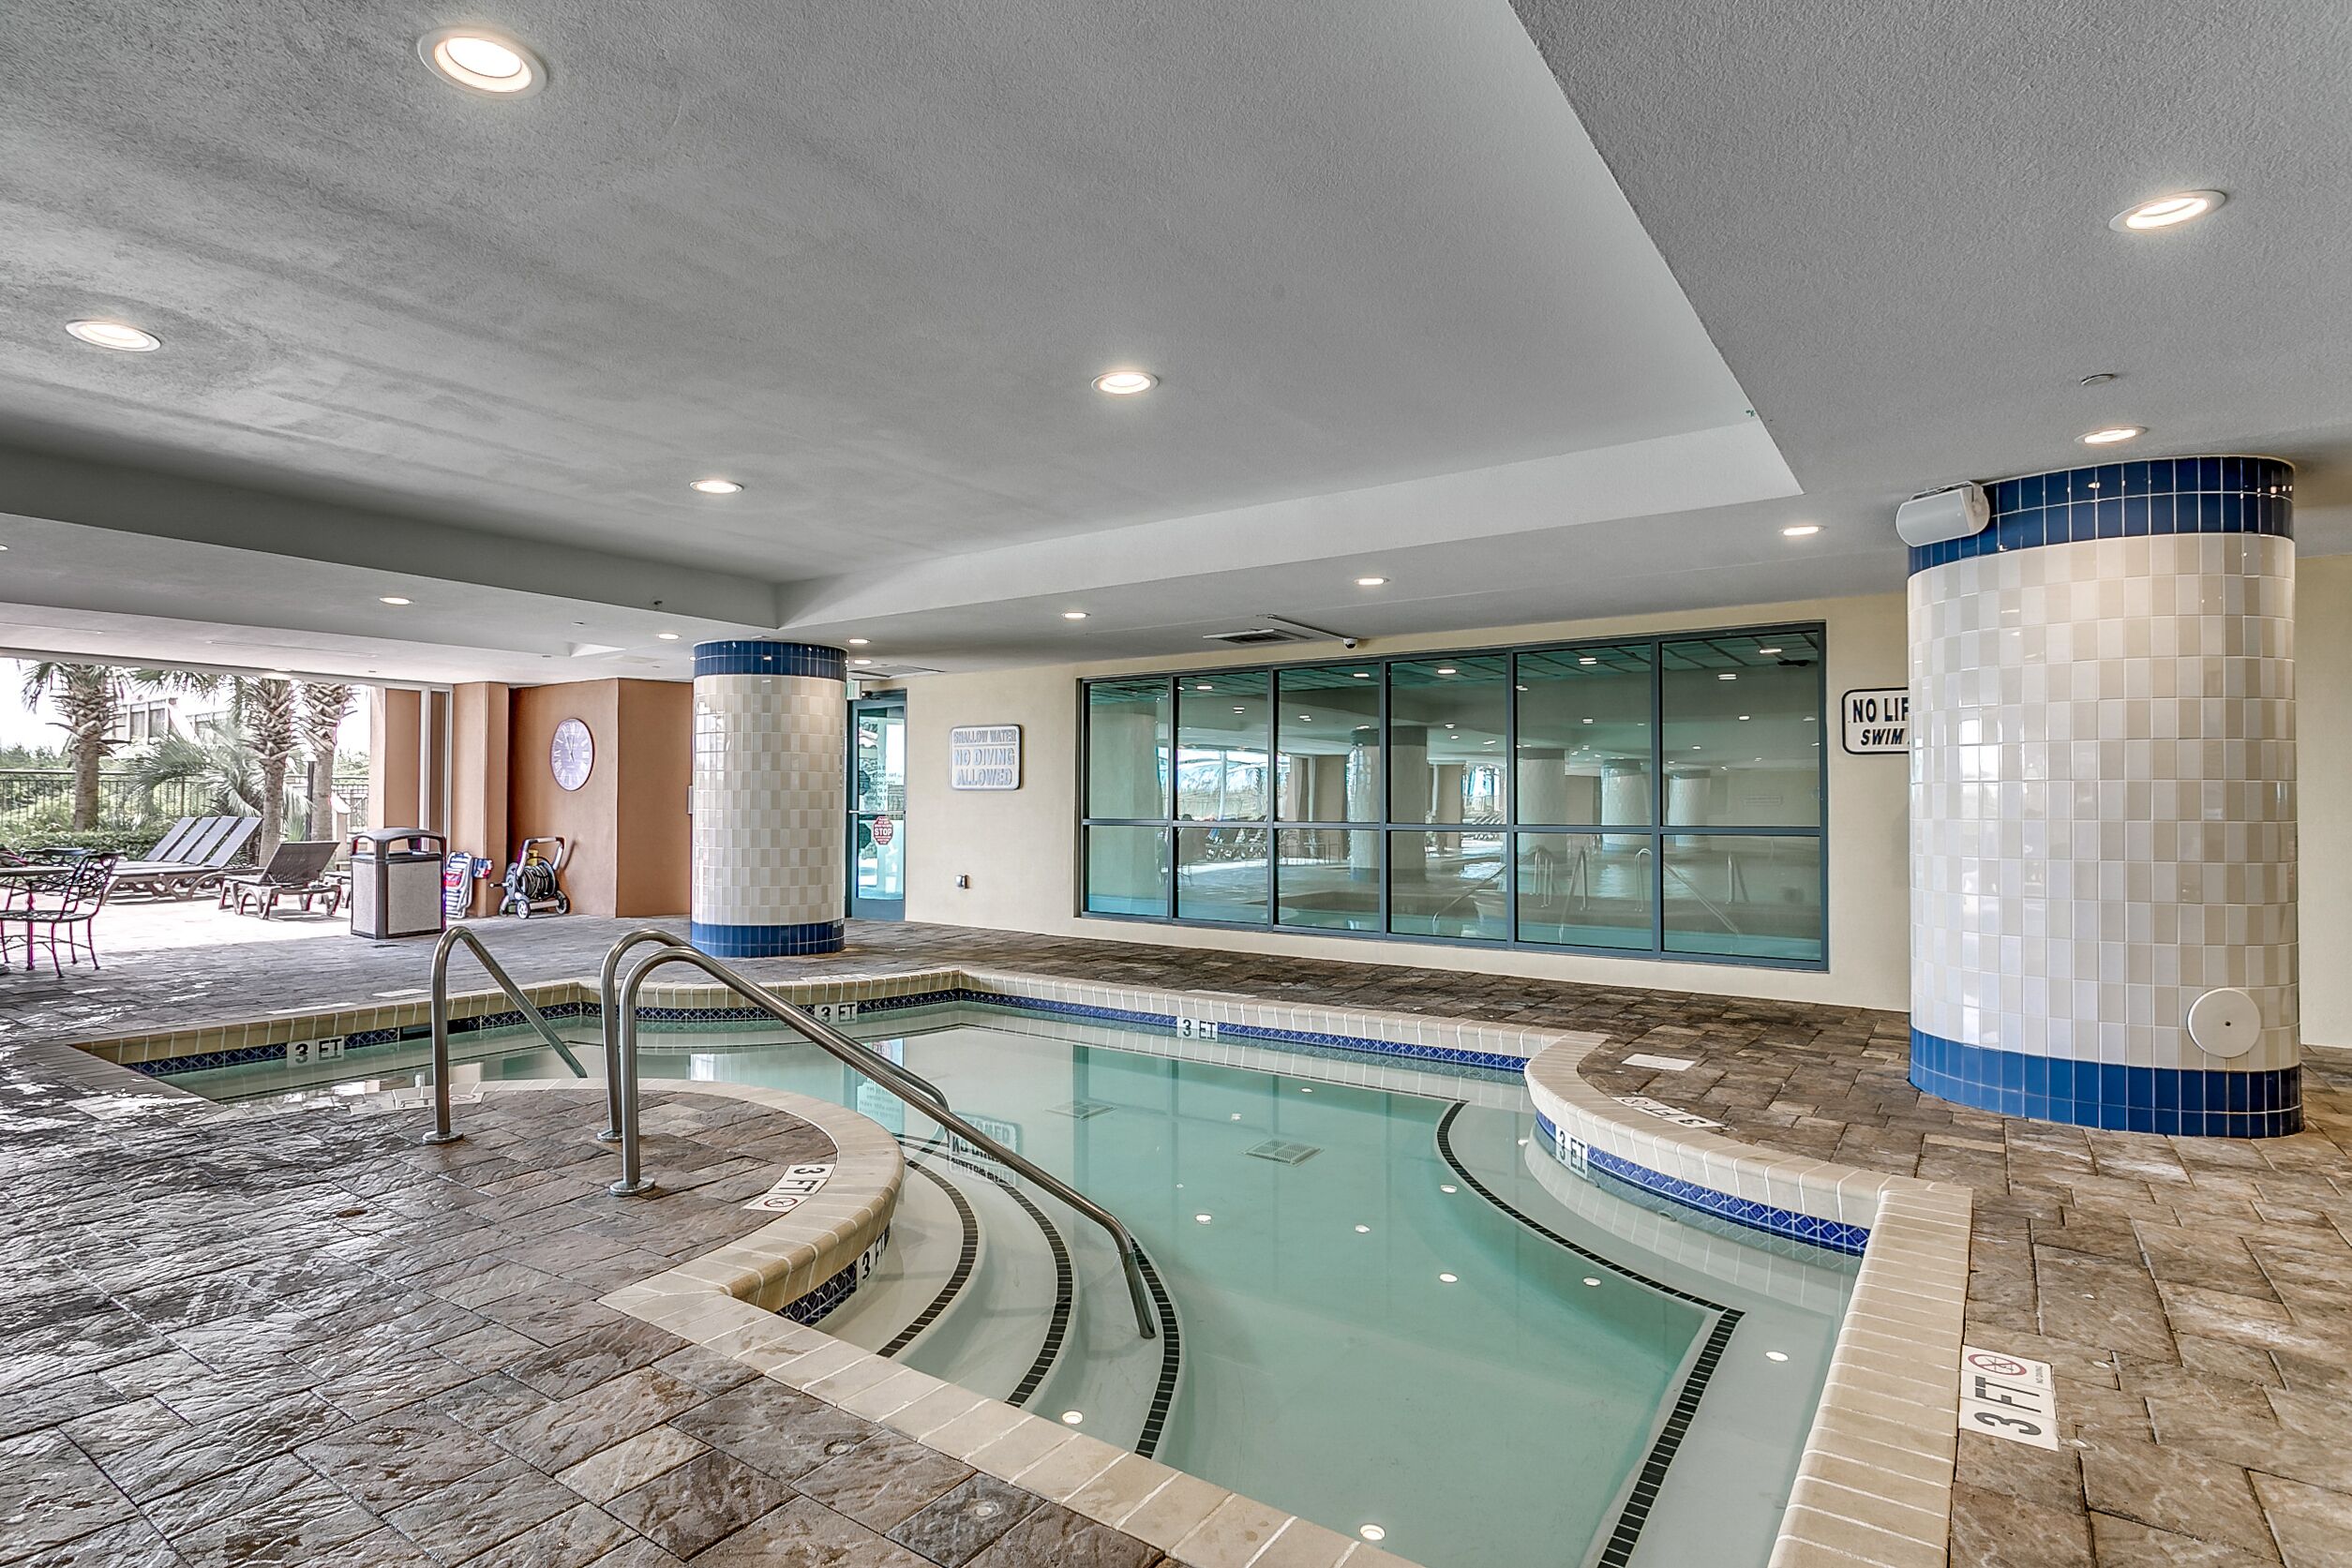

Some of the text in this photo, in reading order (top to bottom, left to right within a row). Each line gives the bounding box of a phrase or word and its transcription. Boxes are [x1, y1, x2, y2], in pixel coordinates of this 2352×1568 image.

[1853, 698, 1877, 723] NO
[953, 728, 1017, 744] SHALLOW WATER
[1861, 728, 1905, 745] SWIM
[954, 747, 1015, 766] NO DIVING
[956, 768, 1013, 786] ALLOWED
[875, 828, 891, 836] STOP
[778, 1179, 819, 1192] FT
[861, 1251, 871, 1279] 3
[1974, 1375, 2042, 1435] 3 FT
